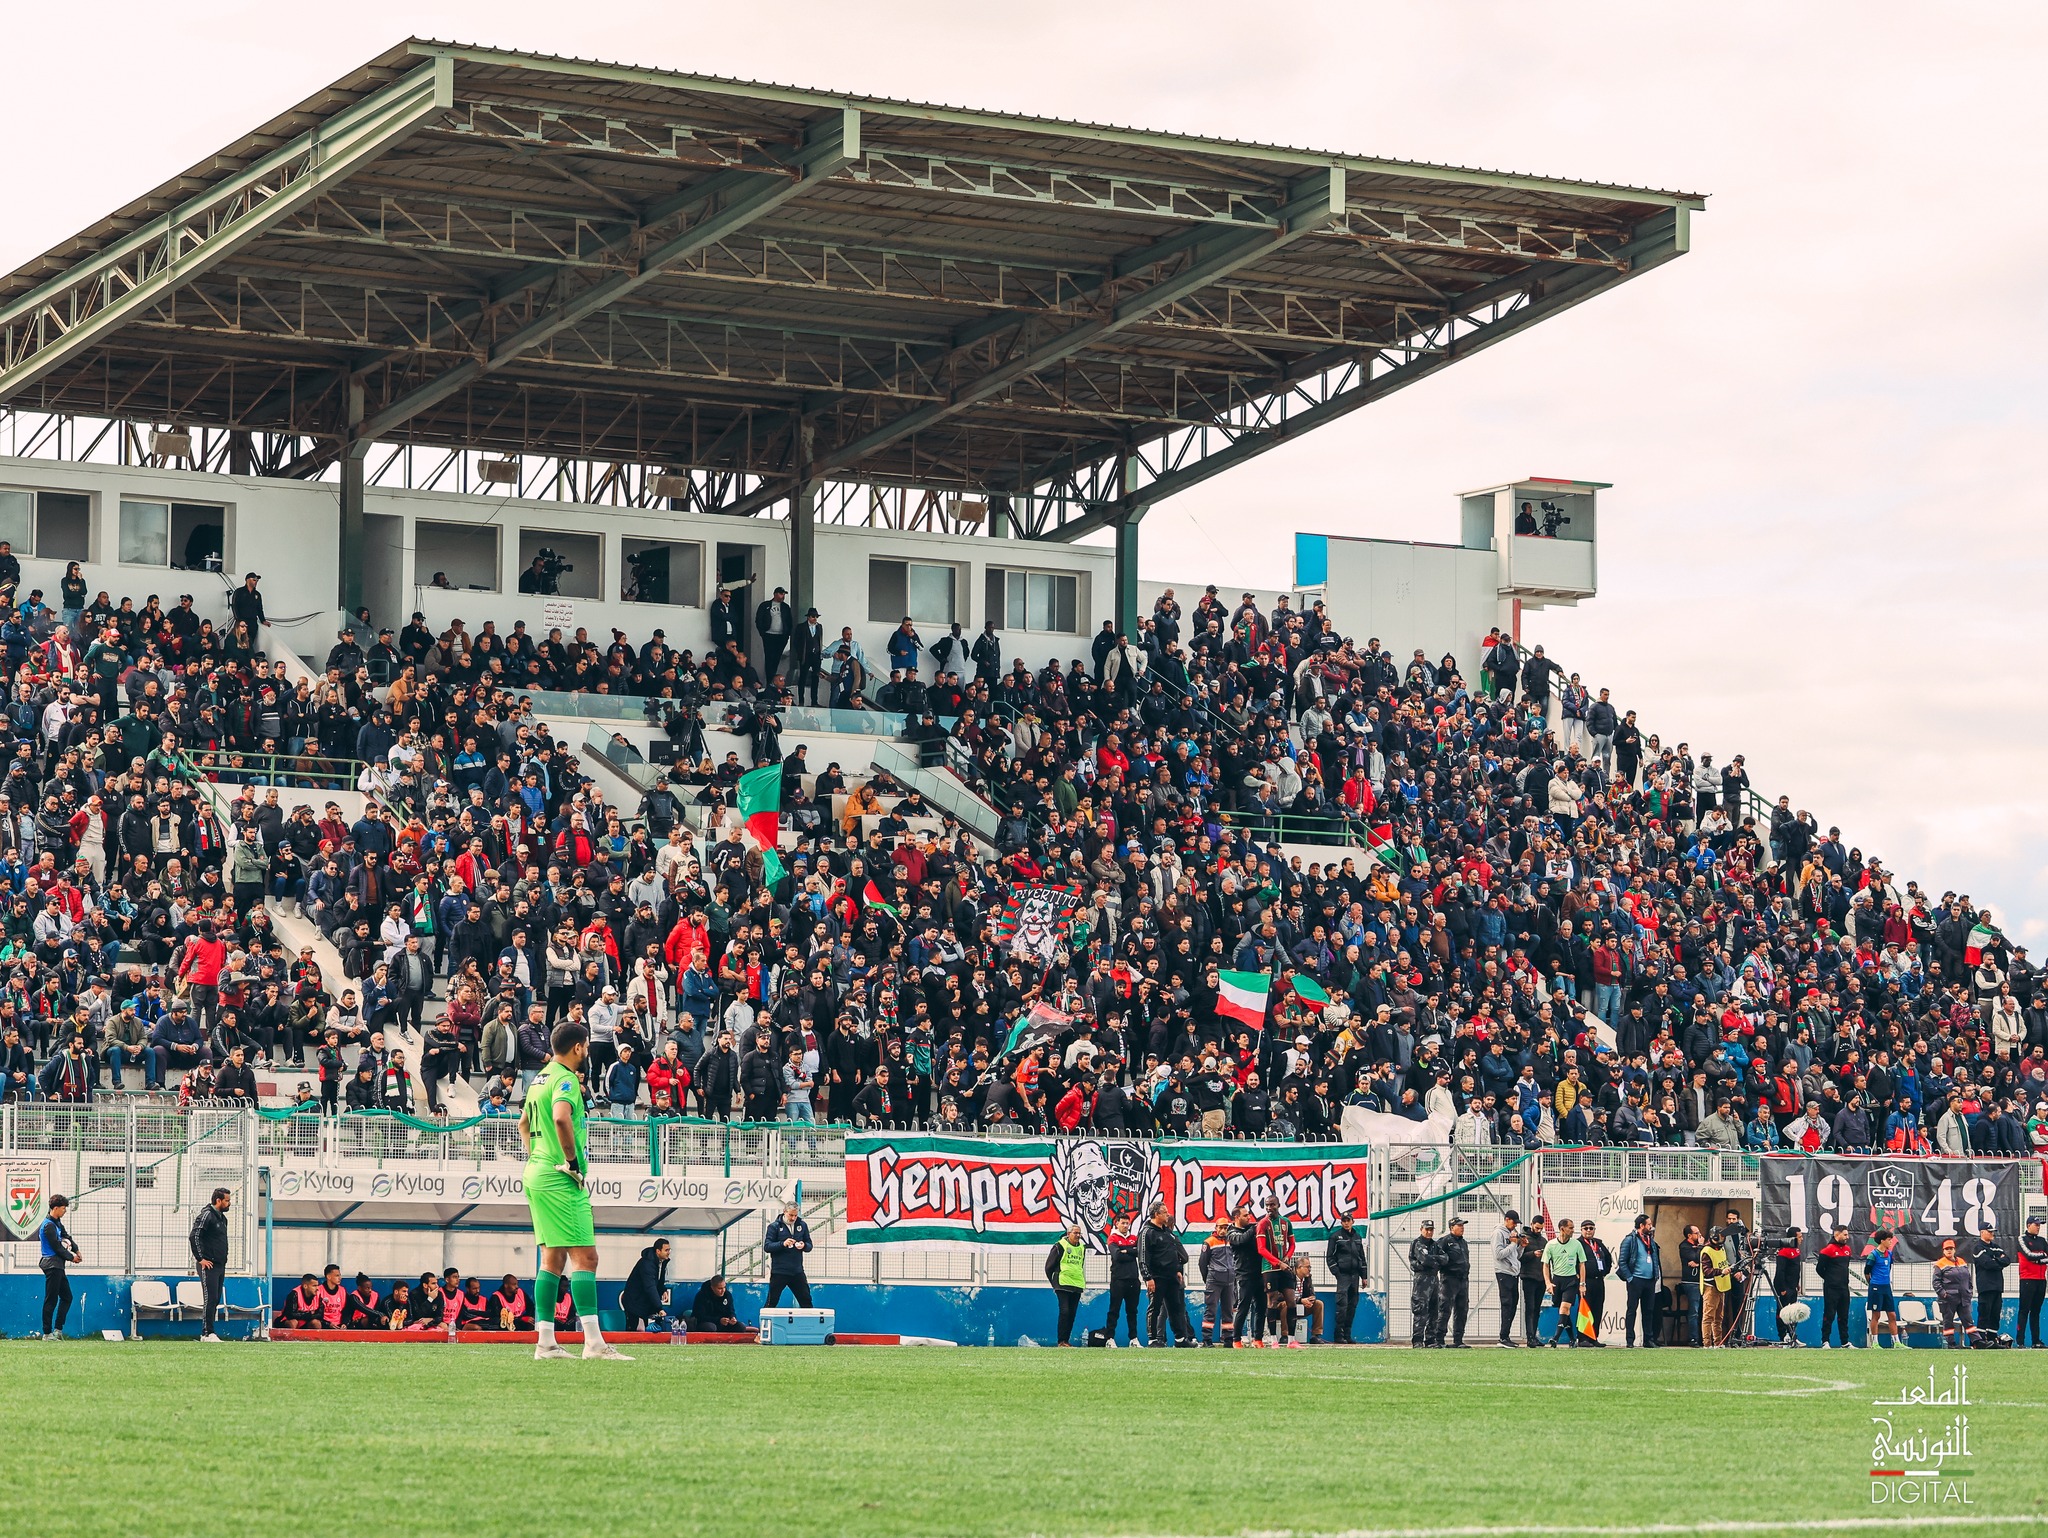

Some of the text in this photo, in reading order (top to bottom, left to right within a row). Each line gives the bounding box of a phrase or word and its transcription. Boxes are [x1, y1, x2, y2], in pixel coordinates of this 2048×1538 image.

[1014, 888, 1078, 908] DIVERTITO
[303, 1170, 354, 1194] Kylog
[395, 1172, 445, 1196] Kylog
[485, 1174, 524, 1198] Kylo
[583, 1179, 622, 1198] ylog
[661, 1178, 709, 1201] Kylog
[747, 1179, 787, 1201] Kylo
[866, 1144, 1359, 1235] Sempre Presente
[1651, 1185, 1667, 1195] Kylog
[1679, 1186, 1695, 1197] Kylog
[1707, 1187, 1723, 1197] Kylog
[1735, 1188, 1751, 1198] Kylog
[1611, 1194, 1639, 1214] Kylog
[1785, 1173, 1854, 1235] 19
[1921, 1176, 1998, 1237] 48
[1600, 1311, 1627, 1335] Kylo
